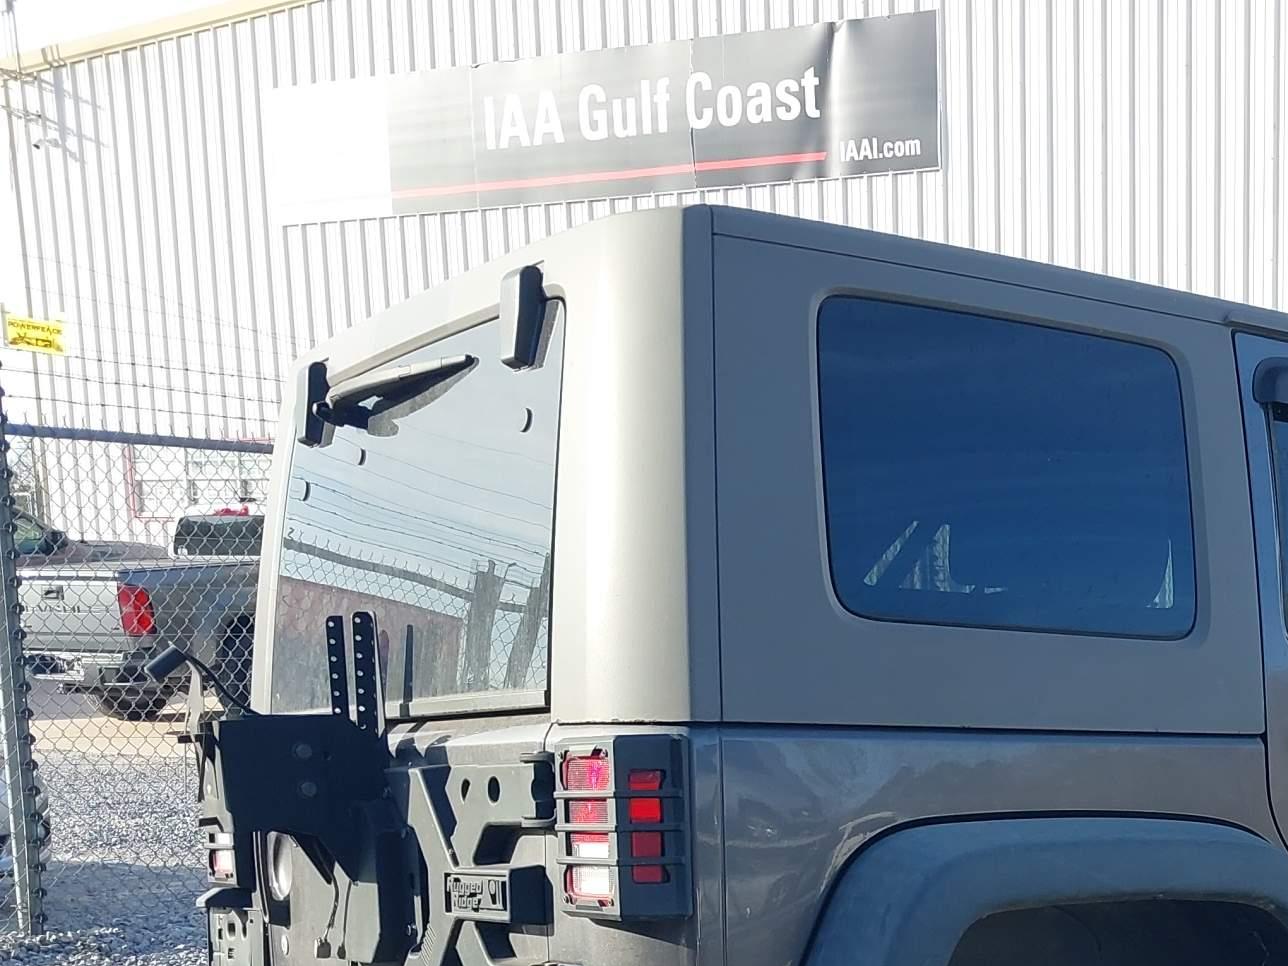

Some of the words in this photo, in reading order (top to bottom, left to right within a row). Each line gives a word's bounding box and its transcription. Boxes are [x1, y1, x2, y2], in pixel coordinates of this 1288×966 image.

[484, 90, 565, 150] IAA
[578, 77, 671, 142] Gulf
[686, 65, 821, 131] Coast
[839, 136, 922, 163] IAAI.com
[447, 876, 482, 896] Rugged
[452, 893, 479, 909] Ridge
